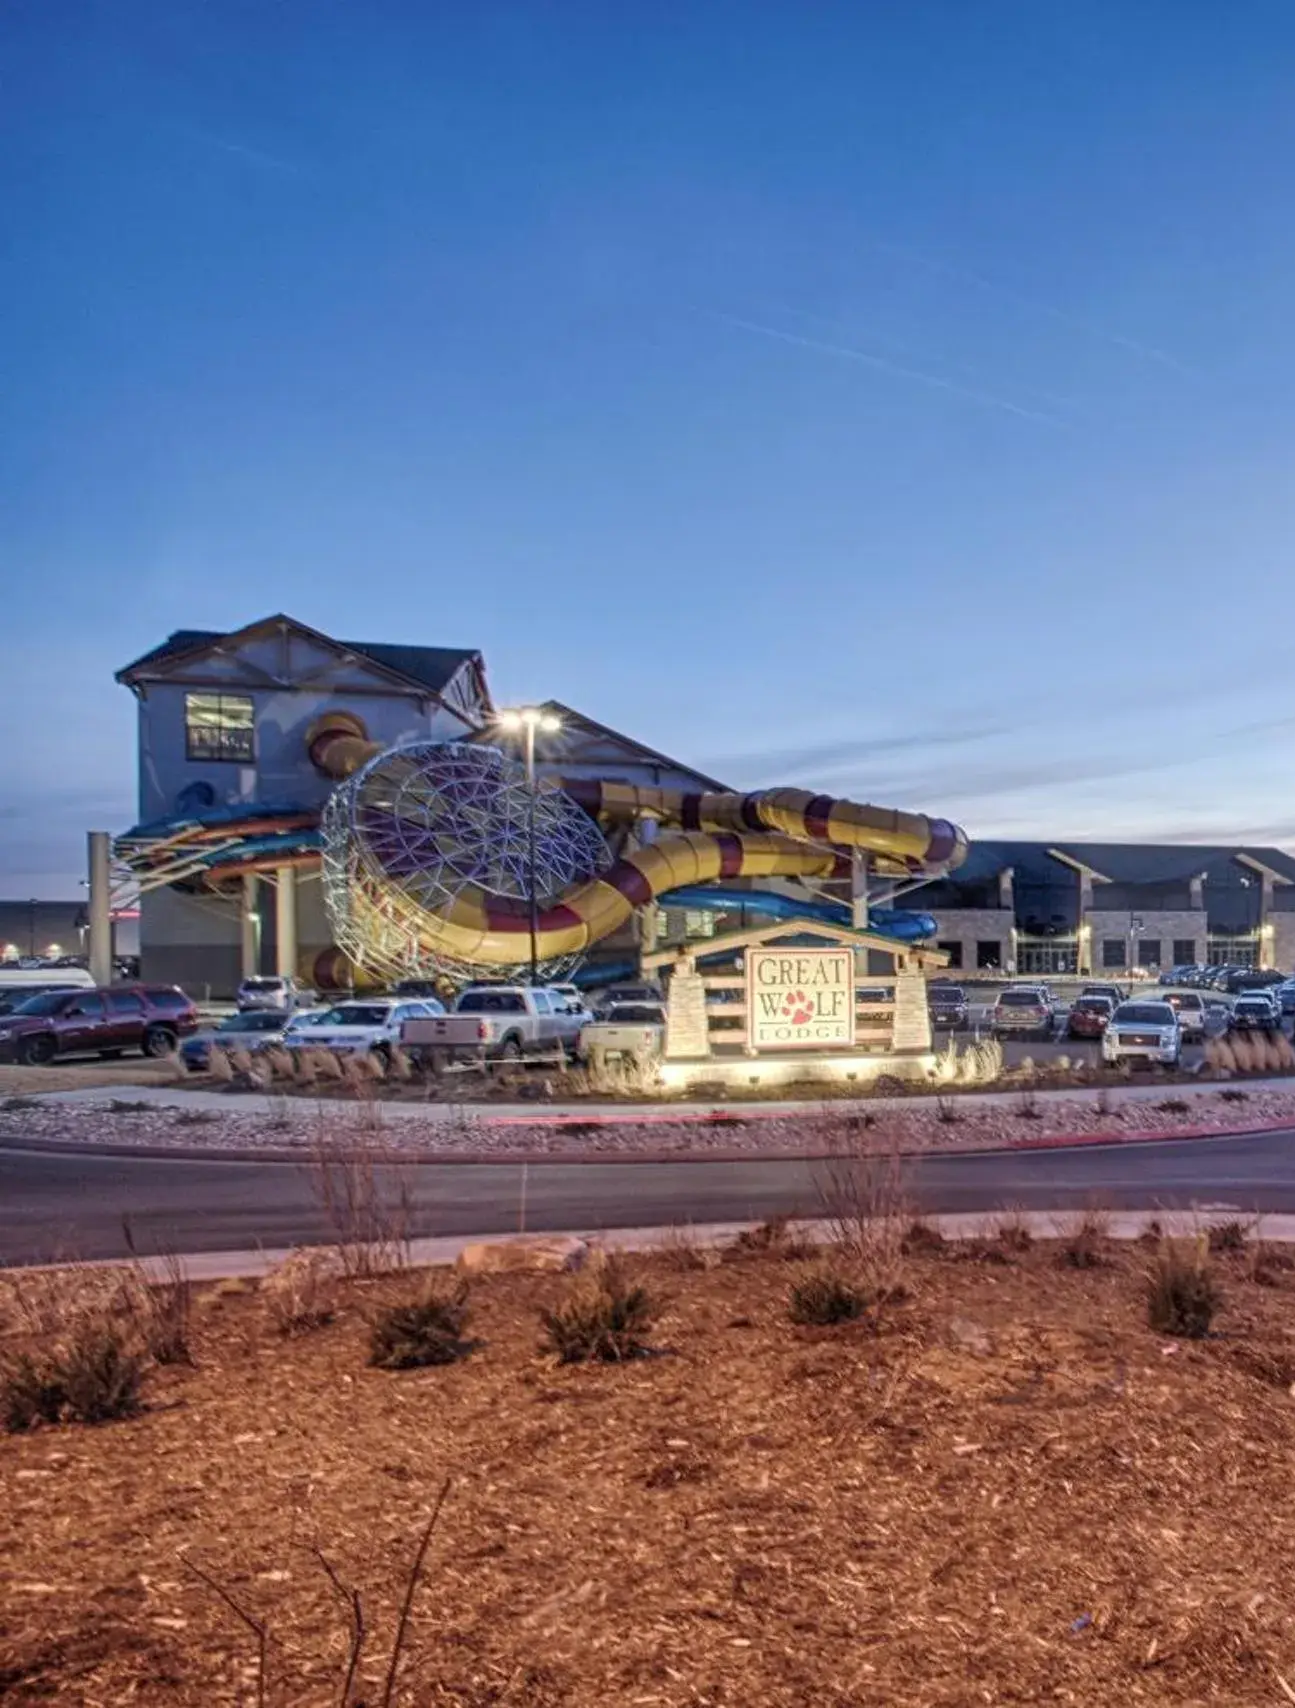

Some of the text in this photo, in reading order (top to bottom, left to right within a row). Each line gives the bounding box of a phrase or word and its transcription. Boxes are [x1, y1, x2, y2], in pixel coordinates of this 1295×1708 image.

[757, 958, 845, 986] GREAT
[758, 990, 845, 1018] WLF
[759, 1026, 845, 1041] LODGE
